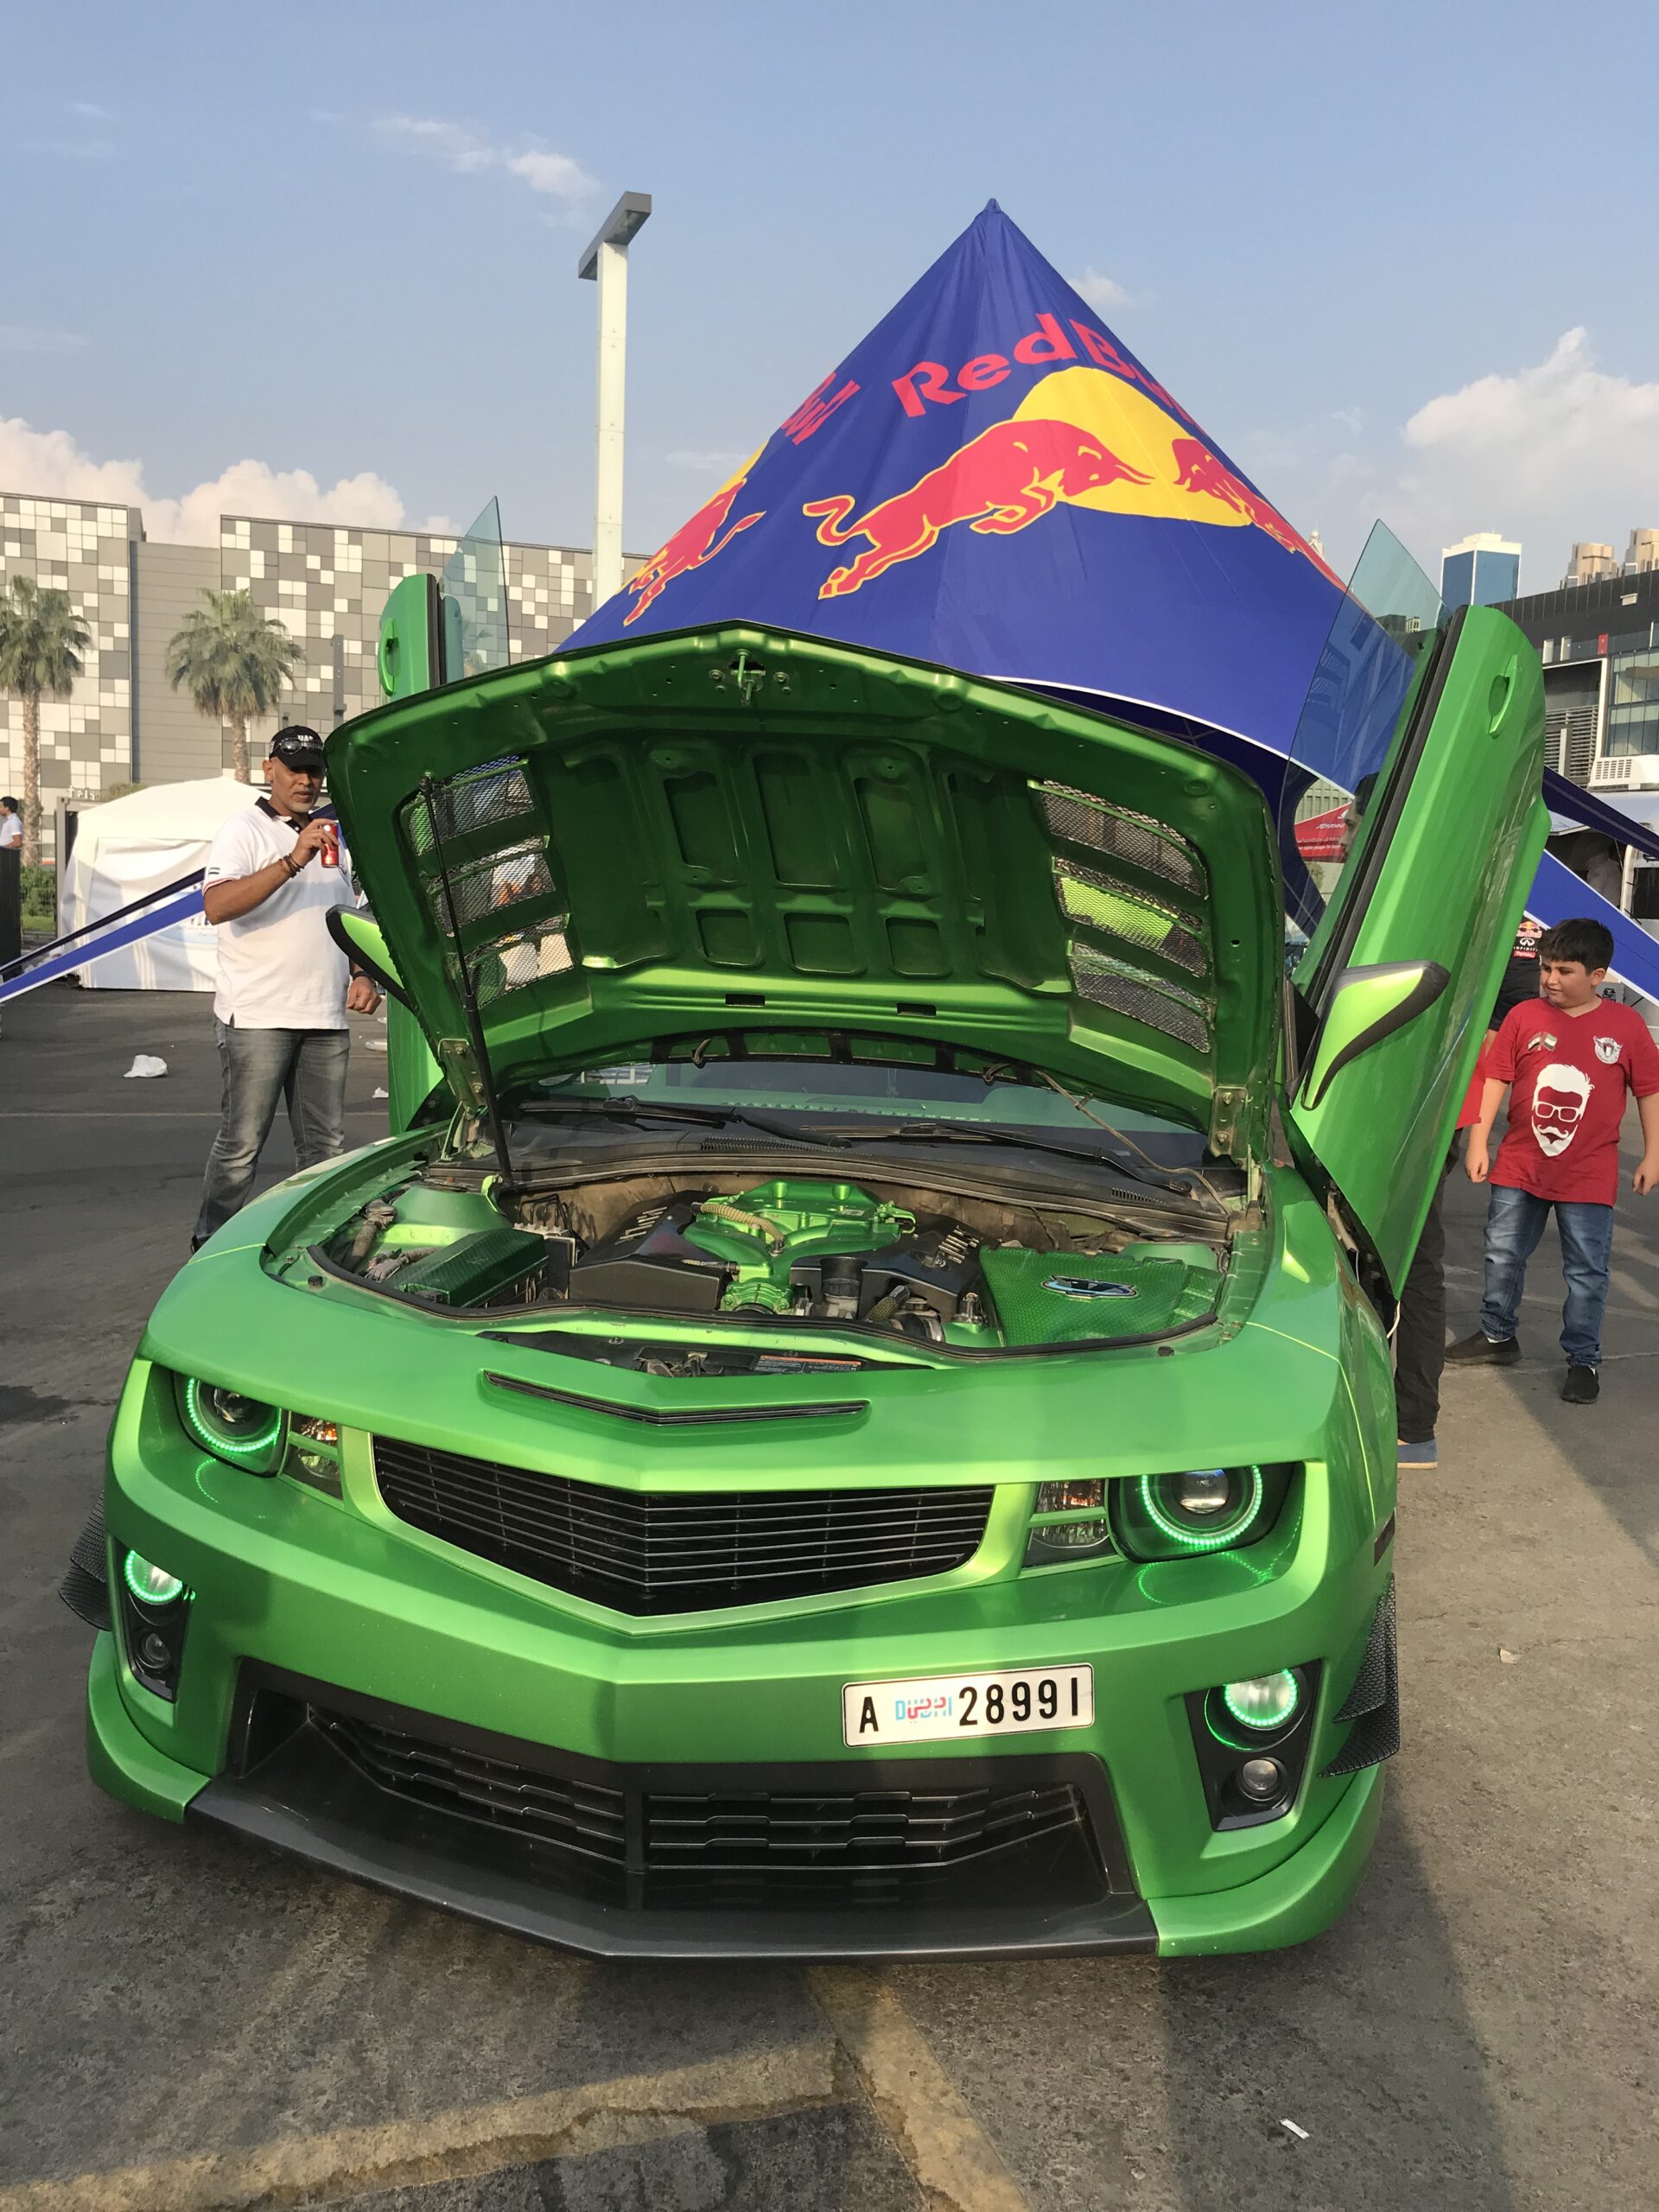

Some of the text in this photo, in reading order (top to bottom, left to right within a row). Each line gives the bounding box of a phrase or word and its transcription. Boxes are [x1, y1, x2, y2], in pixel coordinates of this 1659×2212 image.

[892, 314, 1078, 417] Red
[1069, 319, 1206, 437] Bu
[859, 1696, 880, 1733] A
[958, 1677, 1078, 1726] 28991
